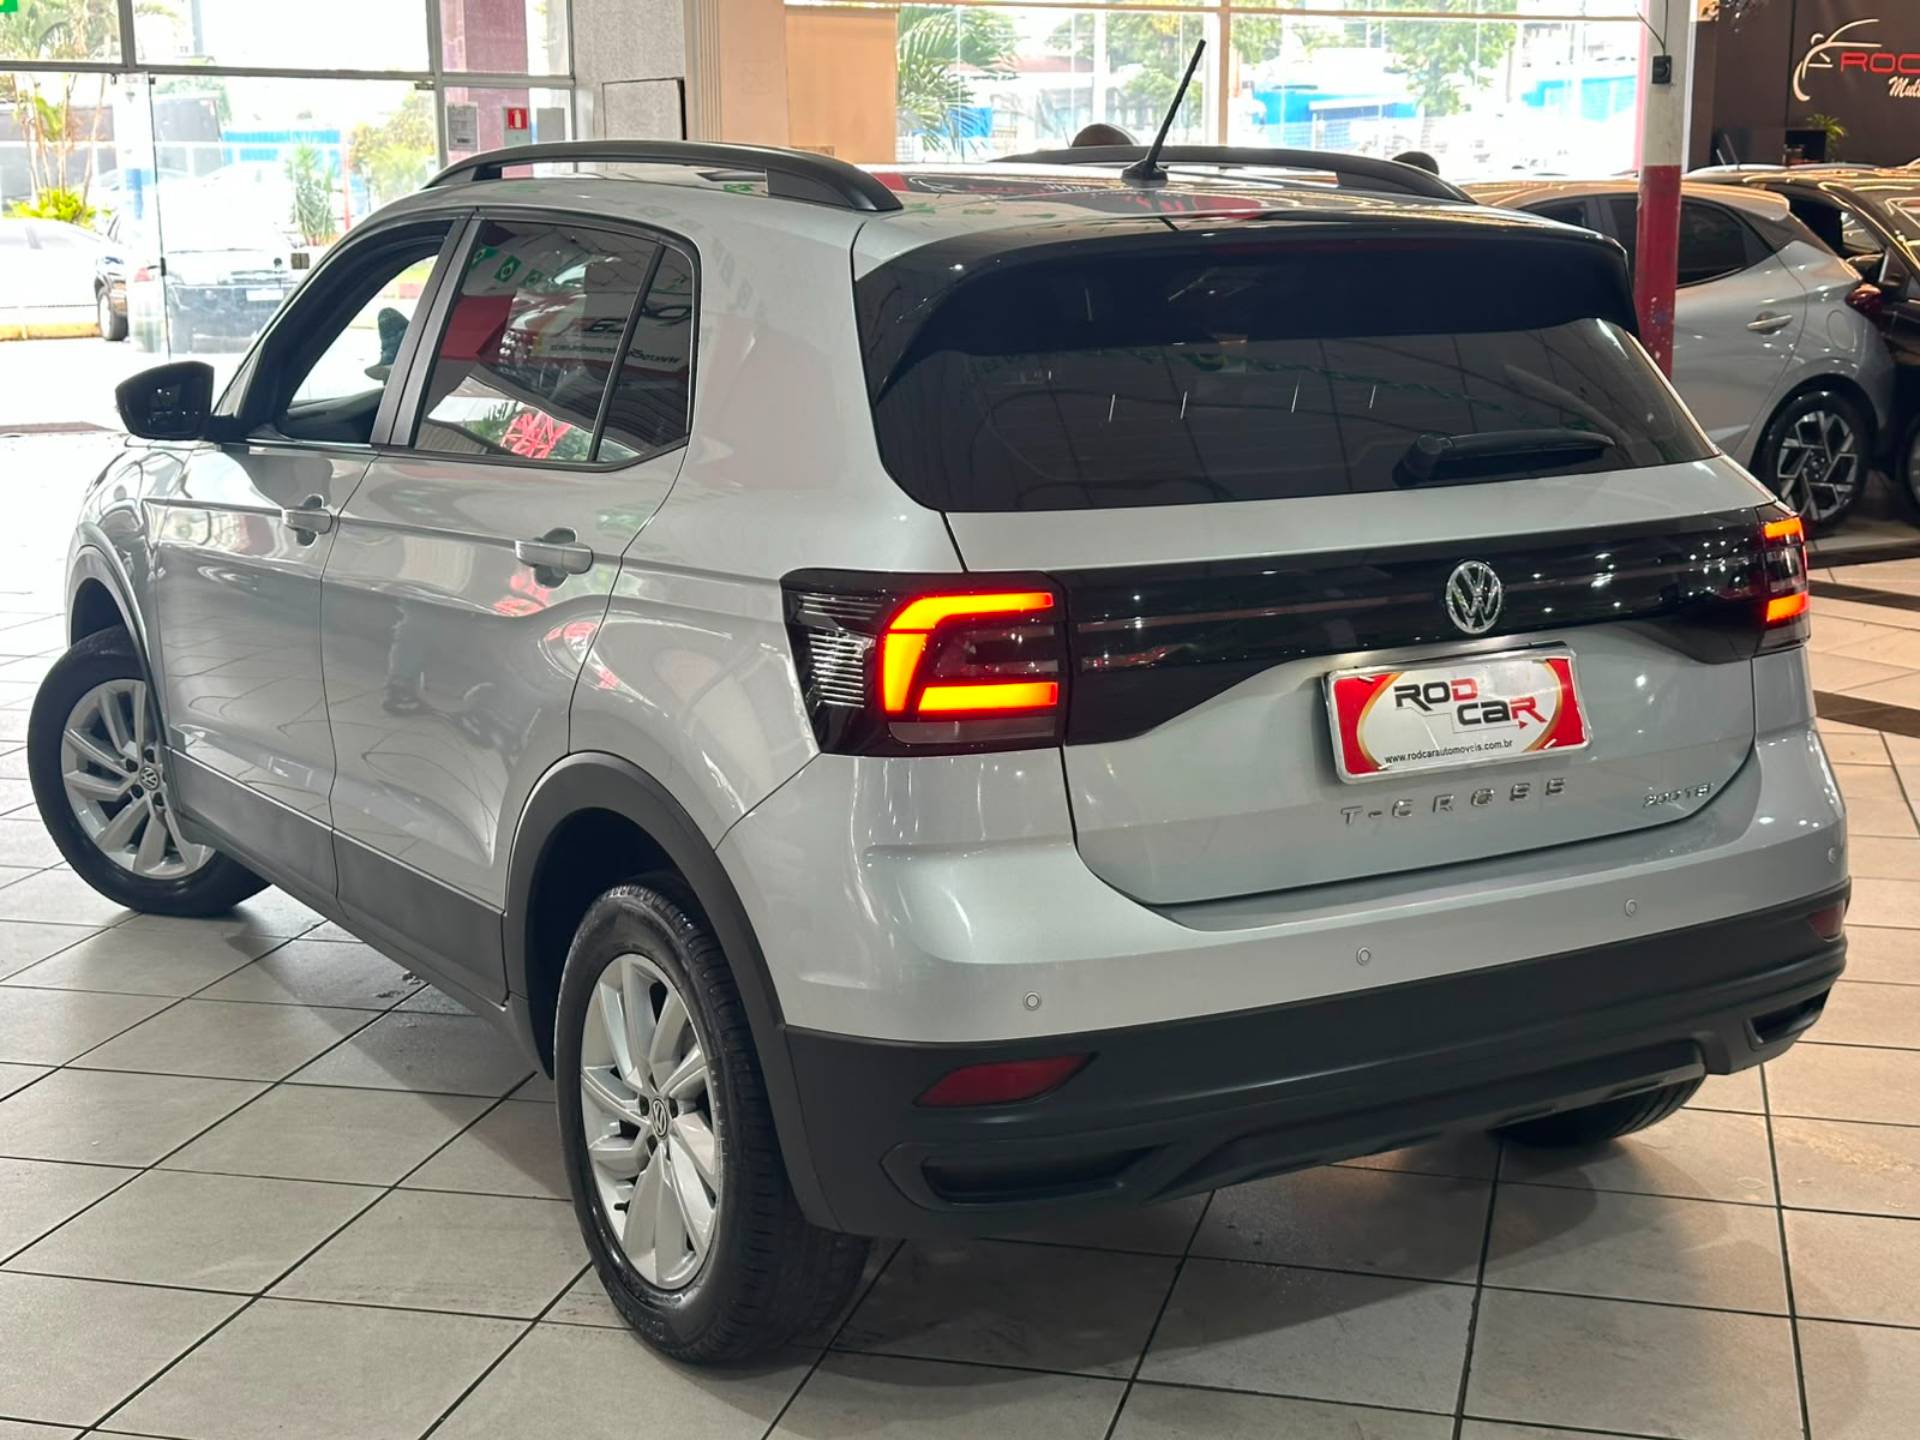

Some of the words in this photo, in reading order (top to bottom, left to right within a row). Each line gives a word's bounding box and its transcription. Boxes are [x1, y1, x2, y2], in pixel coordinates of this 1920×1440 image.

[1393, 677, 1478, 712] ROD
[1384, 738, 1513, 764] www.rodcarautomoveis.com.br
[1340, 777, 1566, 825] T-CROSS
